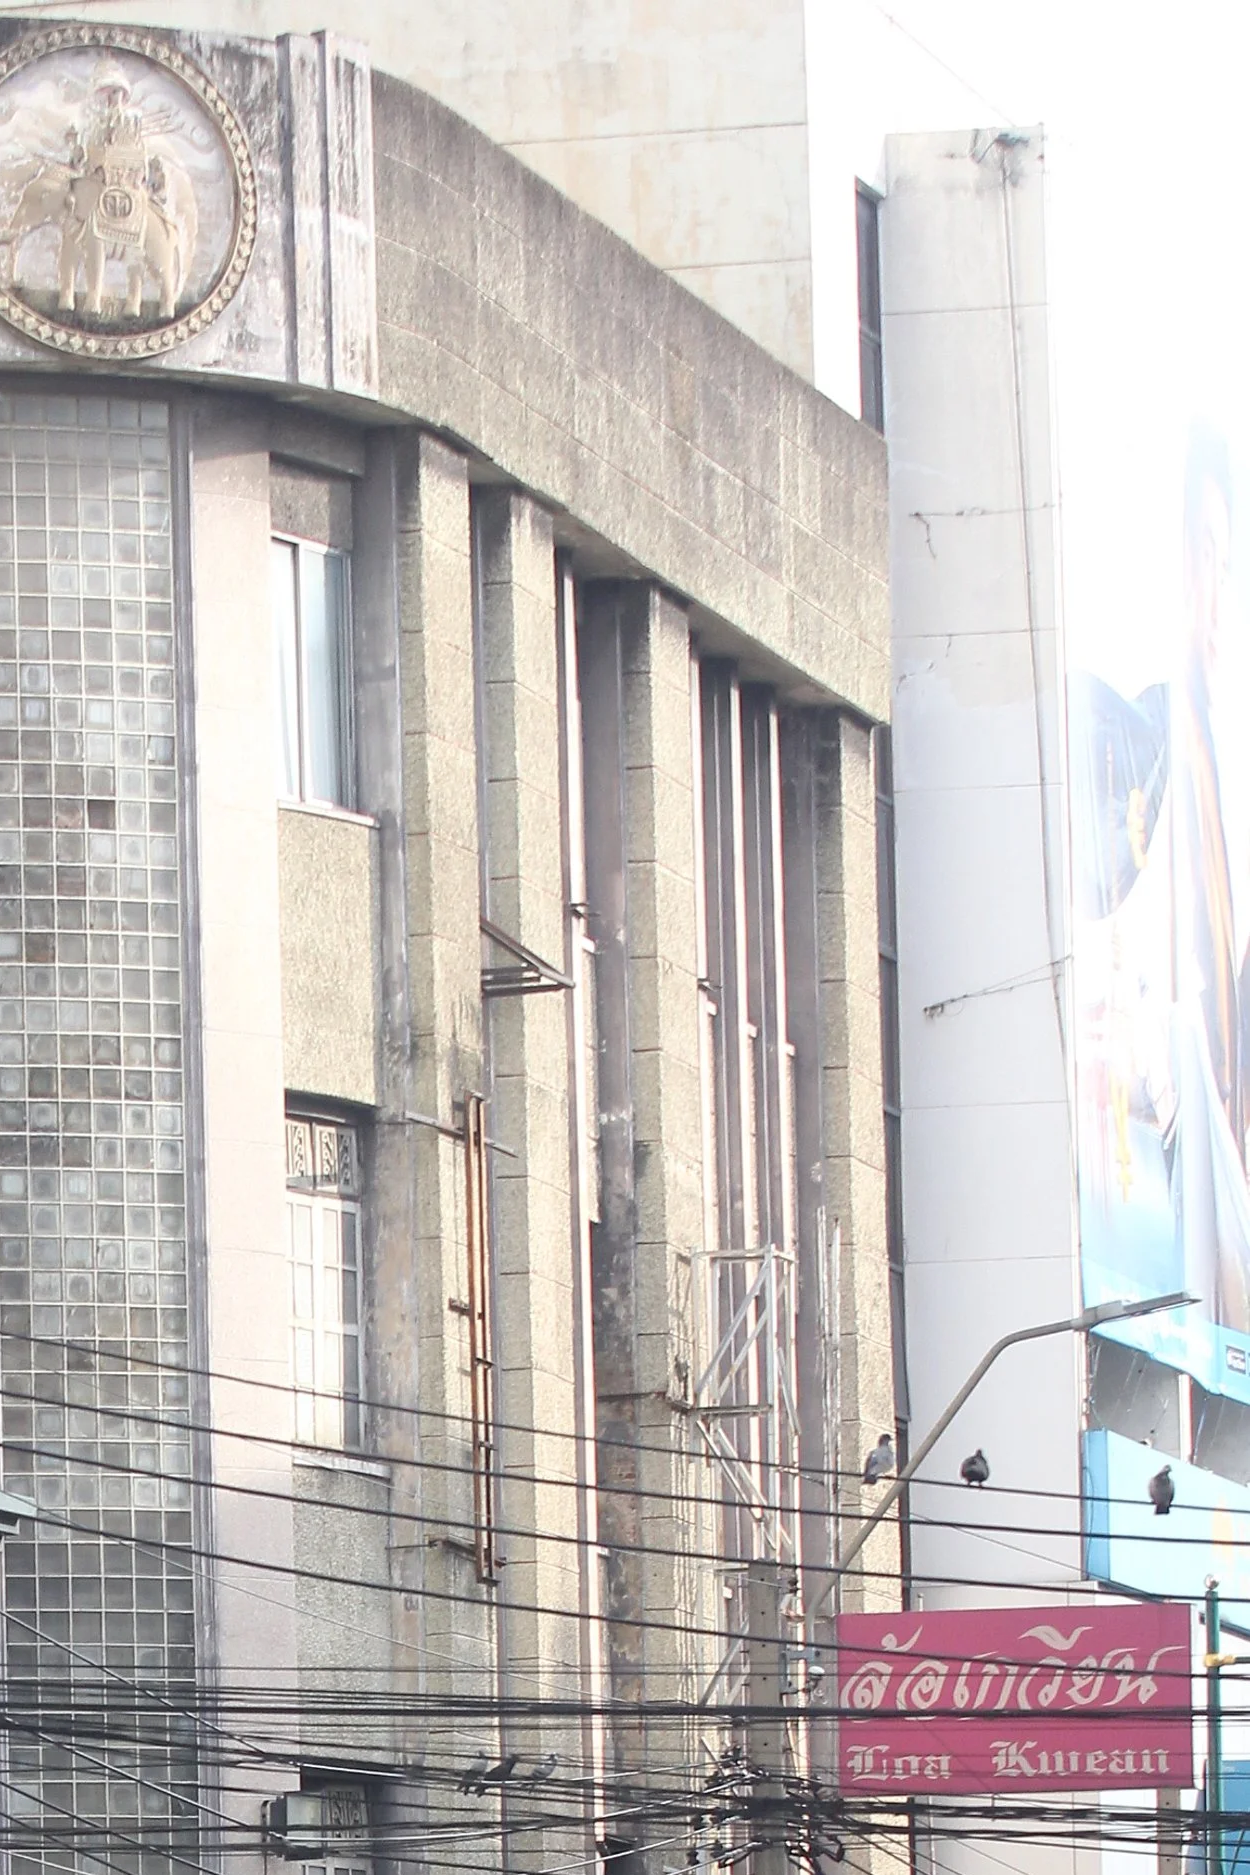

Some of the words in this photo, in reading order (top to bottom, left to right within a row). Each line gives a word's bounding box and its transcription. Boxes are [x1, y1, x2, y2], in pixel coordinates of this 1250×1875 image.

[841, 1625, 1186, 1722] ล้อเกวียน
[847, 1744, 952, 1781] Loa
[989, 1740, 1170, 1778] Kwean
